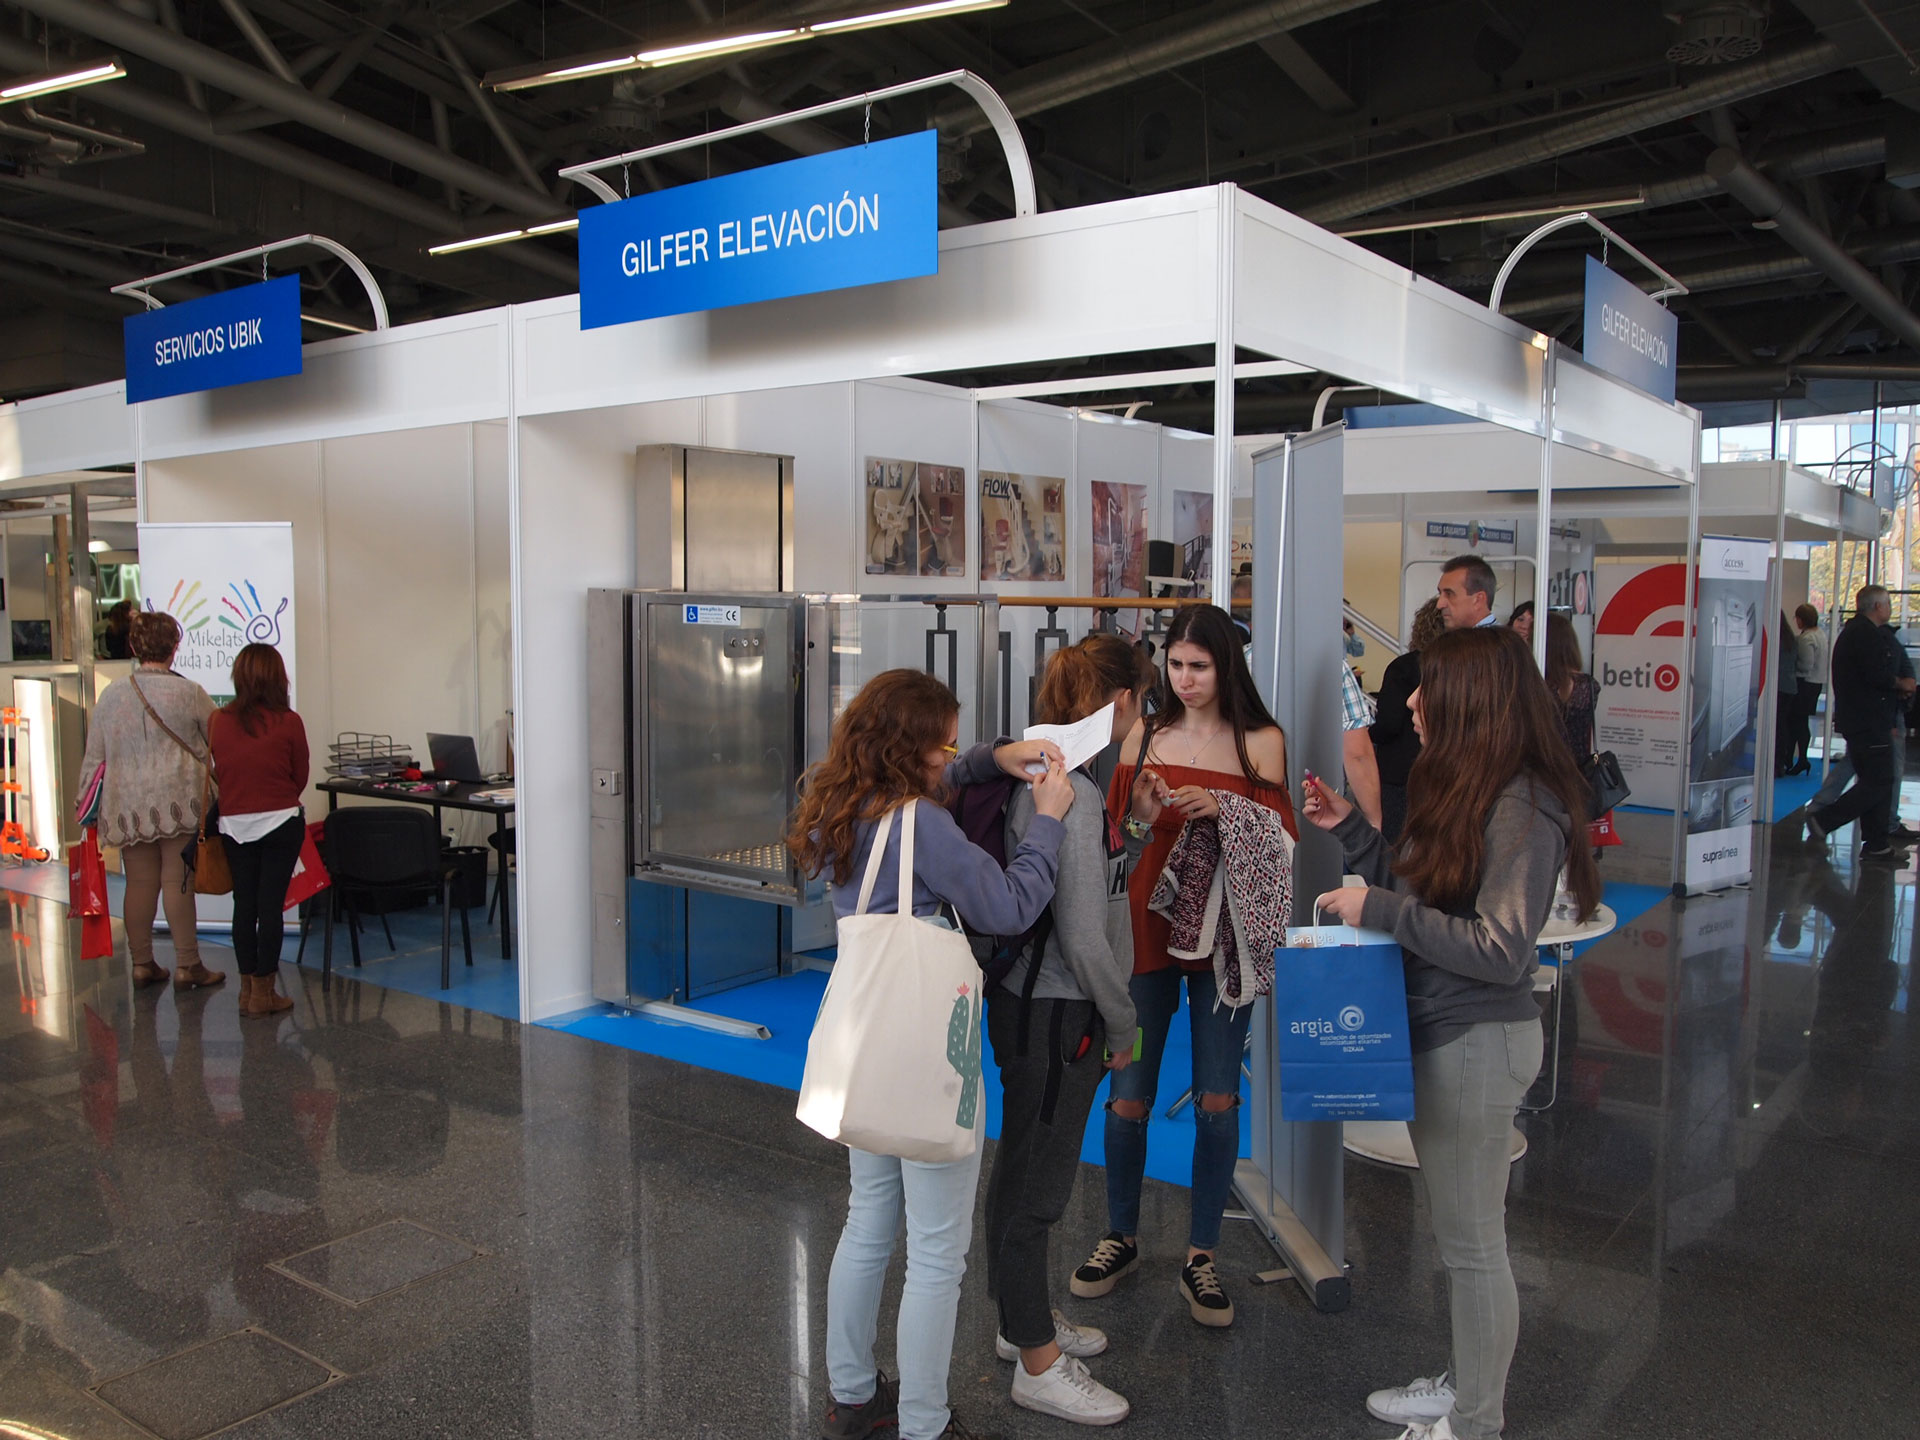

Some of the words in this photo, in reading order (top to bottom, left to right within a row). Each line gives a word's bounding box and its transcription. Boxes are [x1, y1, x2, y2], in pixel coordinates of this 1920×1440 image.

[621, 227, 709, 277] GILFER
[718, 190, 879, 259] ELEVACIÓN
[155, 326, 225, 366] SERVICIOS
[228, 317, 262, 350] UBIK
[1601, 303, 1630, 344] GILFER
[1631, 322, 1668, 368] ELEVACIÓN
[187, 627, 243, 649] Mikelats
[173, 648, 201, 670] yuda
[205, 654, 212, 669] a
[216, 650, 235, 668] Do
[1111, 856, 1129, 895] H
[1290, 1018, 1334, 1037] argia
